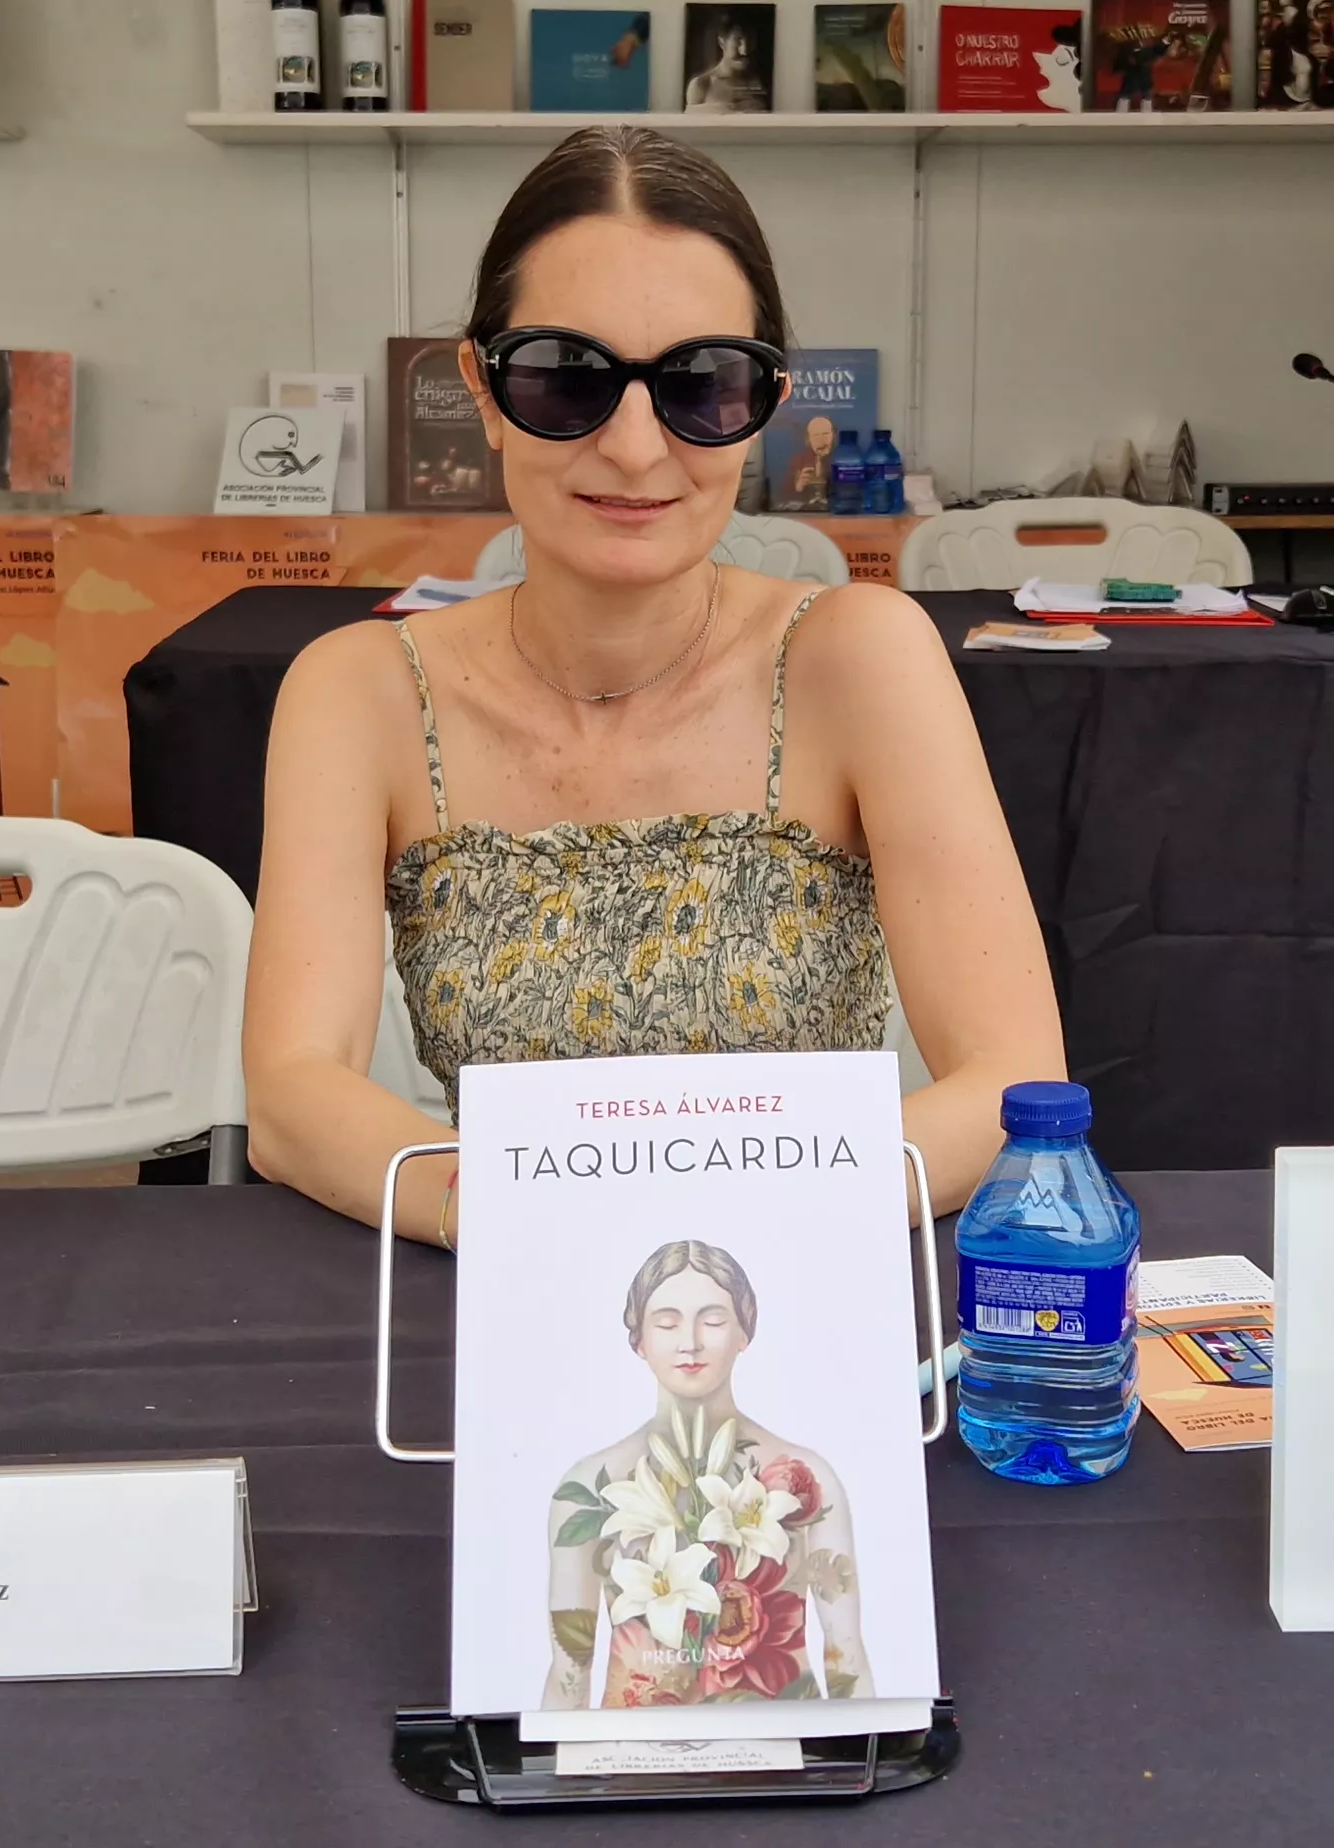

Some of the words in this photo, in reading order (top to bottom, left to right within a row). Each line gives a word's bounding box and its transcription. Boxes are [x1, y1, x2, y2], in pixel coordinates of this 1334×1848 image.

[1168, 11, 1207, 28] Goya
[791, 366, 856, 385] RAMÓN
[802, 385, 856, 401] CAJAL
[276, 485, 325, 493] PROVINCIAL
[9, 550, 55, 563] LIBRO
[201, 551, 246, 563] FERIA
[252, 551, 279, 563] DEL
[286, 551, 331, 563] LIBRO
[246, 567, 265, 580] DE
[272, 567, 331, 580] HUESCA
[576, 1099, 667, 1119] TERESA
[676, 1092, 784, 1115] ÁLVAREZ
[503, 1135, 859, 1181] TAQUICARDIA
[1186, 1422, 1226, 1431] LIBRO
[1229, 1418, 1255, 1426] DEL
[641, 1645, 746, 1666] PREGUNTA
